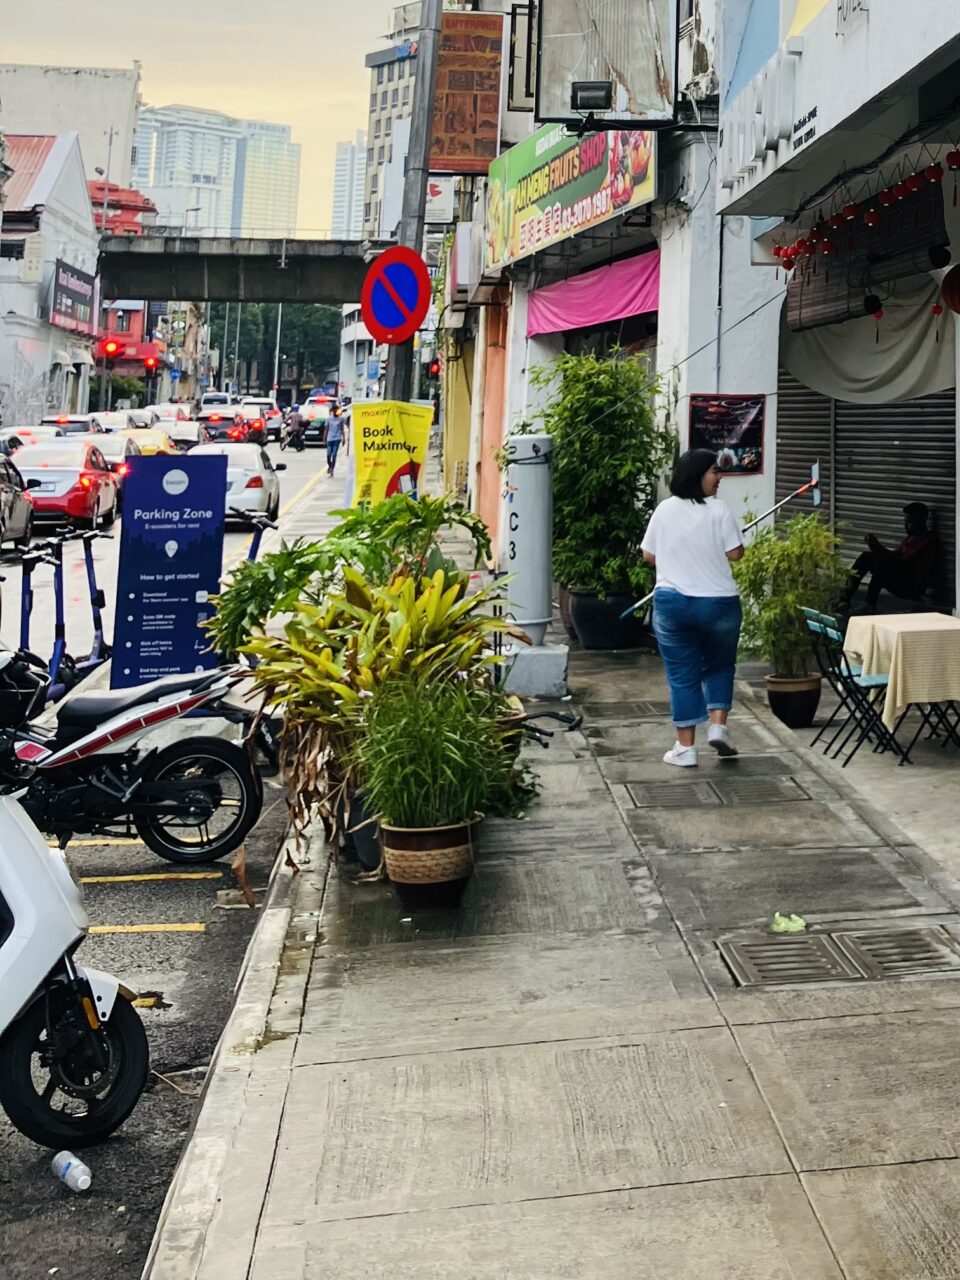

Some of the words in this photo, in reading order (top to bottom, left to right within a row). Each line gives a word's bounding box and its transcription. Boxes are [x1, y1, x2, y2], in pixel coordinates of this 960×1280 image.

[528, 165, 550, 204] MENG
[549, 147, 580, 192] FRUITS
[580, 131, 607, 175] SHOP
[362, 424, 394, 439] Book
[133, 508, 180, 522] Parking
[182, 508, 213, 519] Zone
[164, 573, 176, 582] get
[176, 572, 200, 580] started
